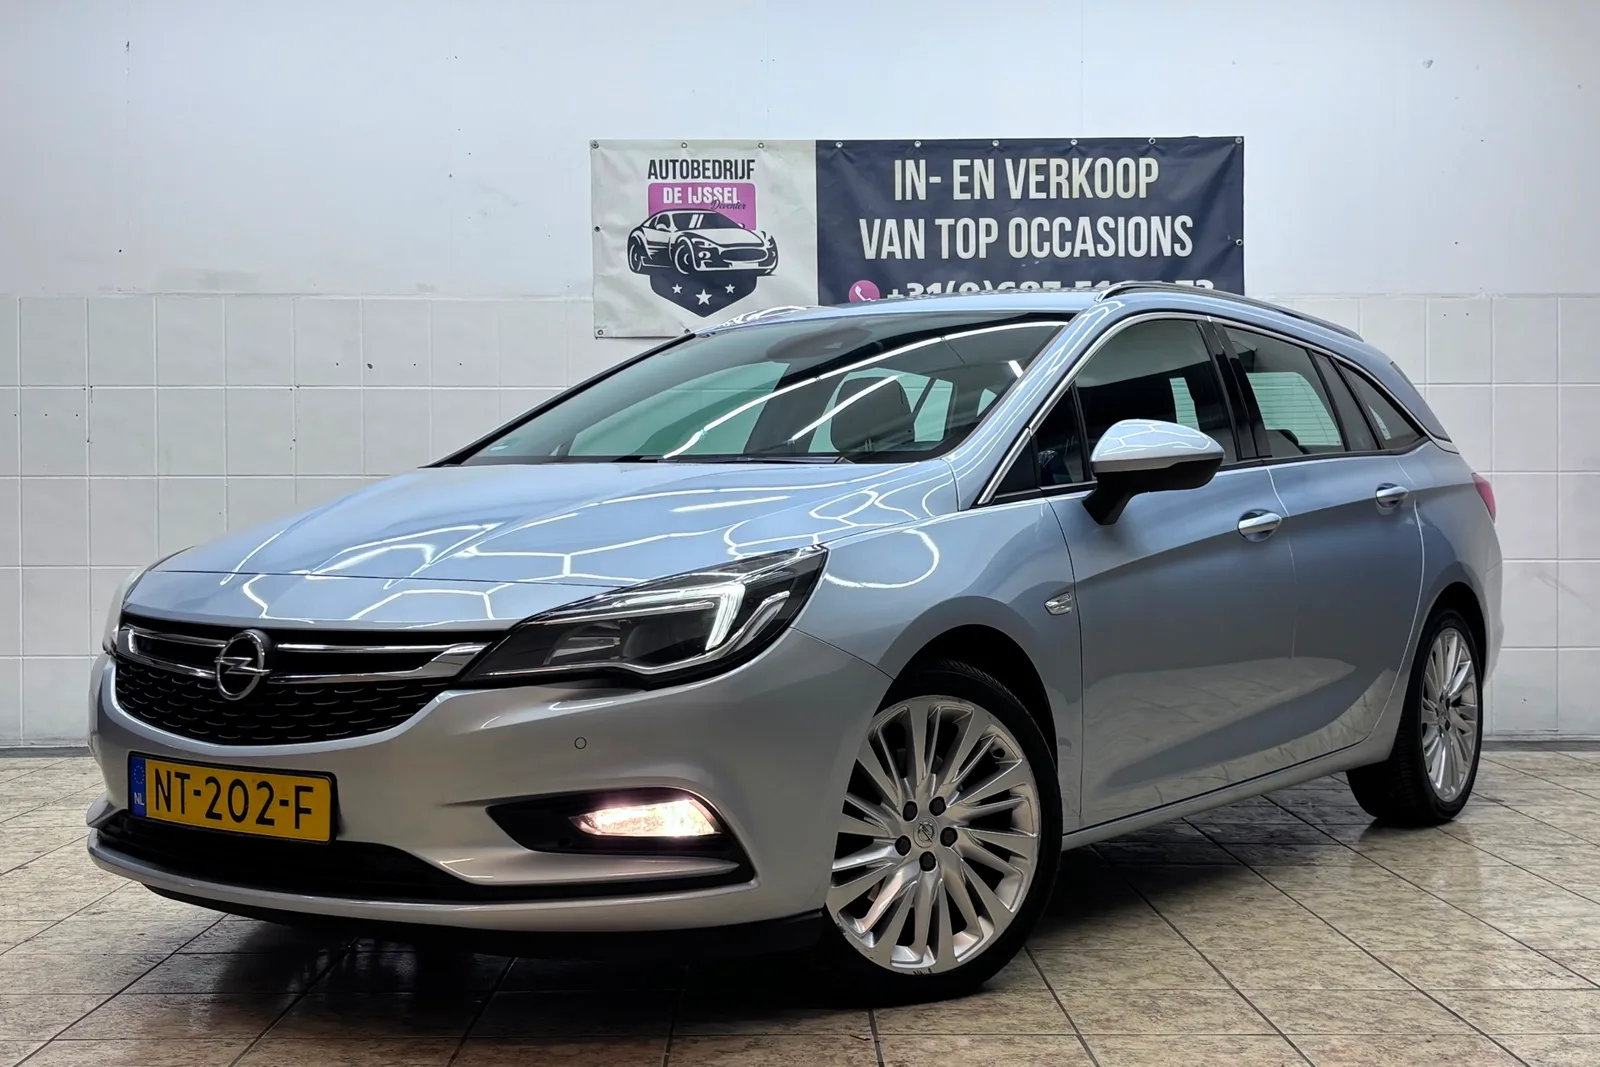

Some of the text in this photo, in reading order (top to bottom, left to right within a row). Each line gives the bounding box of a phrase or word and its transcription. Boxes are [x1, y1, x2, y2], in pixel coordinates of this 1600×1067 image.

[648, 159, 756, 180] AUTOBEDRIJF
[894, 157, 1159, 201] IN- EN VERKOOP
[663, 186, 741, 205] DE IJSSEL
[859, 214, 1194, 260] VAN TOP OCCASIONS
[133, 791, 145, 806] NL
[154, 768, 314, 830] NT-202-F
